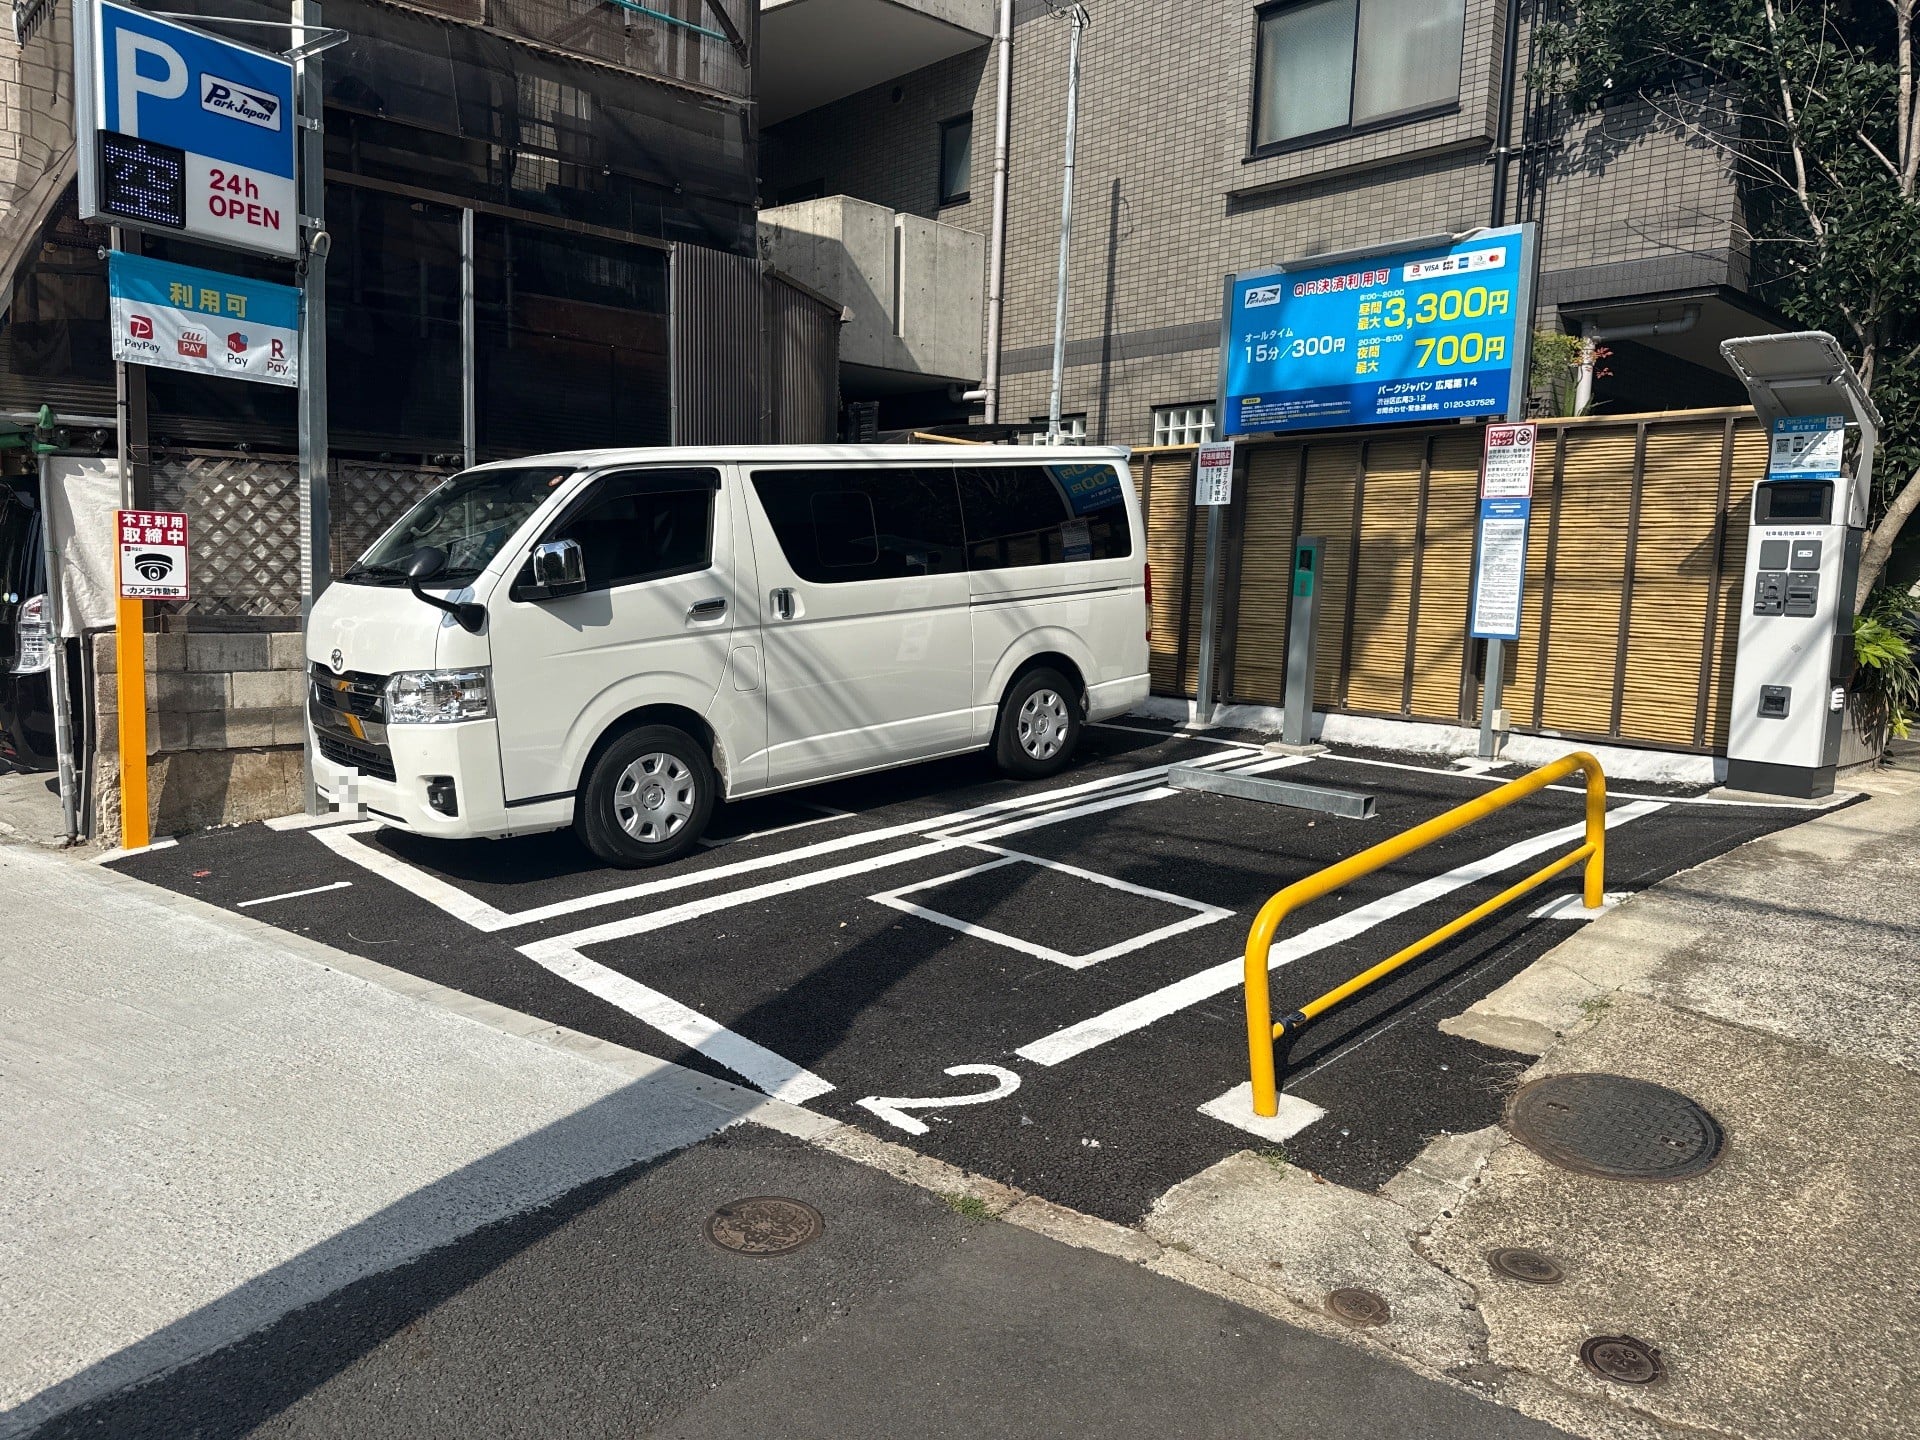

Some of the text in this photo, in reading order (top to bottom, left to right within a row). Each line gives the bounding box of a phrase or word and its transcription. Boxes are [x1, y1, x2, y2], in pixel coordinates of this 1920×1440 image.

[115, 27, 189, 137] P
[204, 82, 271, 121] Park Japan
[105, 144, 180, 224] 空
[209, 168, 259, 200] 24h
[209, 194, 280, 231] OPEN
[1424, 263, 1440, 273] VISA
[1293, 267, 1391, 298] QR決済利用可
[169, 281, 248, 319] 利用可
[1358, 300, 1383, 316] 昼間
[1383, 286, 1510, 330] 3,300円
[1357, 315, 1382, 331] 最大
[181, 330, 204, 342] au
[1245, 327, 1294, 343] オールタイム
[124, 338, 161, 354] PayPay
[183, 344, 203, 354] PAY
[1357, 345, 1380, 359] 夜間
[1415, 332, 1506, 369] 700円
[227, 353, 249, 368] Pay
[267, 361, 289, 375] Pay
[1355, 360, 1380, 374] 最大
[1377, 380, 1433, 395] パークジャパン
[1490, 438, 1513, 446] ストップ
[1491, 430, 1514, 439] アイドリング
[122, 513, 184, 529] 不正利用
[122, 526, 185, 545] 取締中
[129, 586, 180, 596] カメラ作動中
[855, 1063, 1022, 1136] 2
